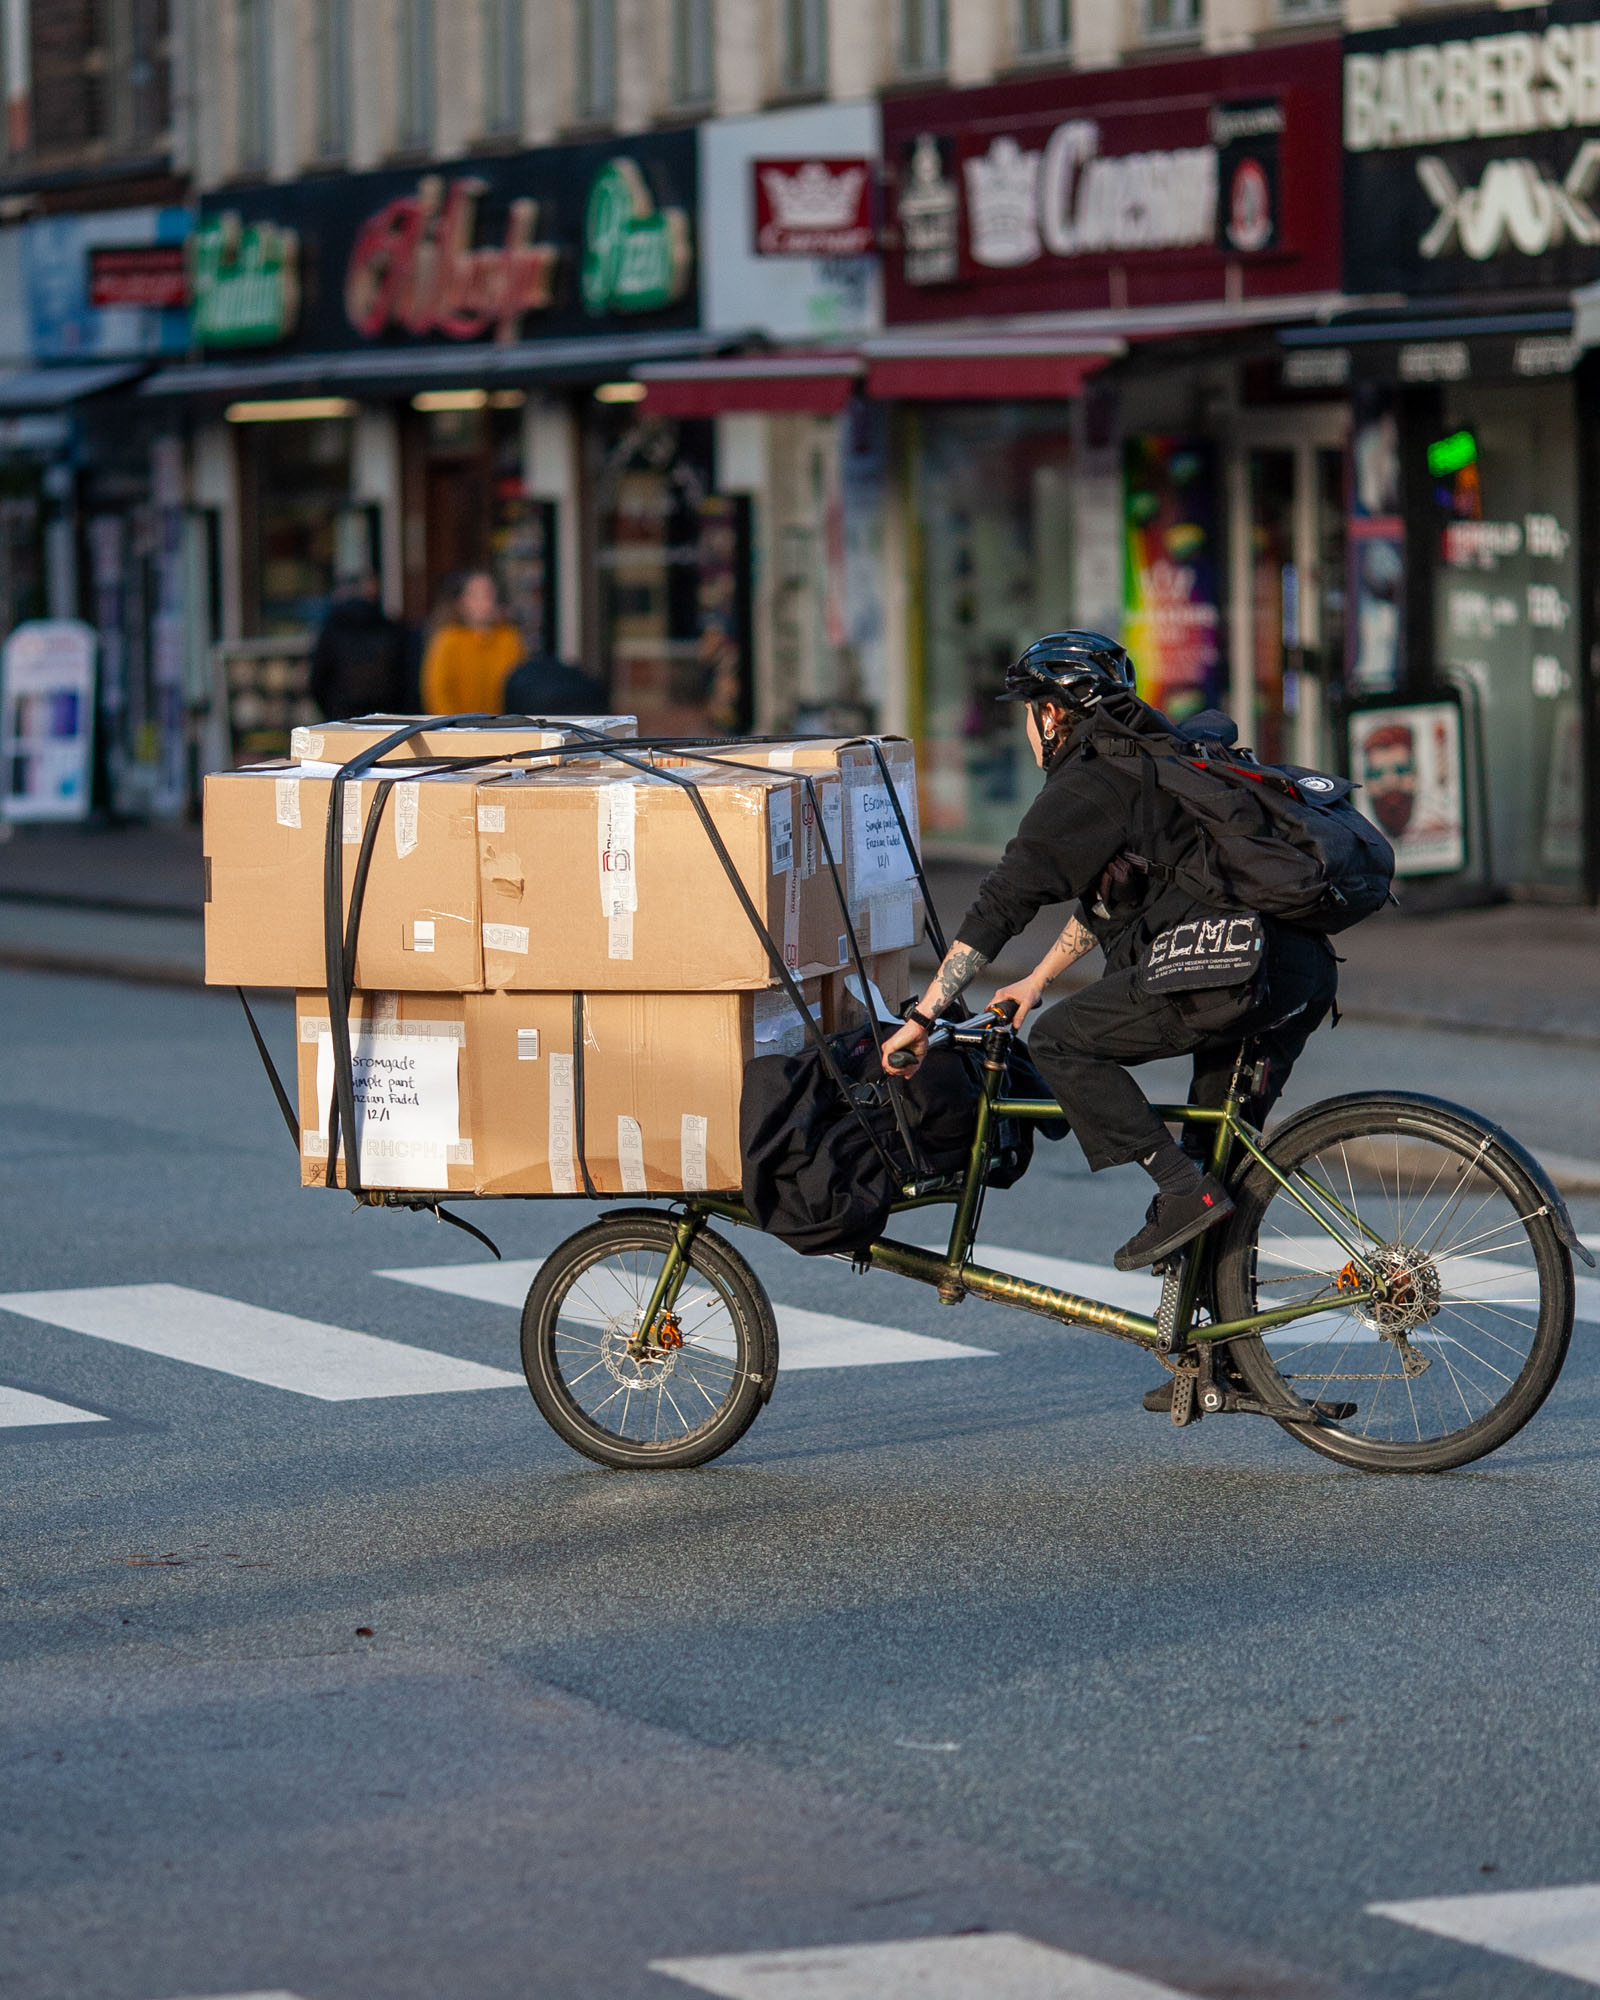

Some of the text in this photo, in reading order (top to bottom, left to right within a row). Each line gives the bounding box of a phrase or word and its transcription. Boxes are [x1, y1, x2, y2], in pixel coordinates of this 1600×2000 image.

[1343, 30, 1534, 152] BARBER
[1148, 917, 1256, 967] ECMC
[353, 1056, 416, 1072] sromgade
[388, 1077, 416, 1093] pant
[353, 1093, 420, 1107] nzian Faded
[367, 1107, 391, 1122] 12/1
[988, 1272, 1129, 1332] OMNIUM
